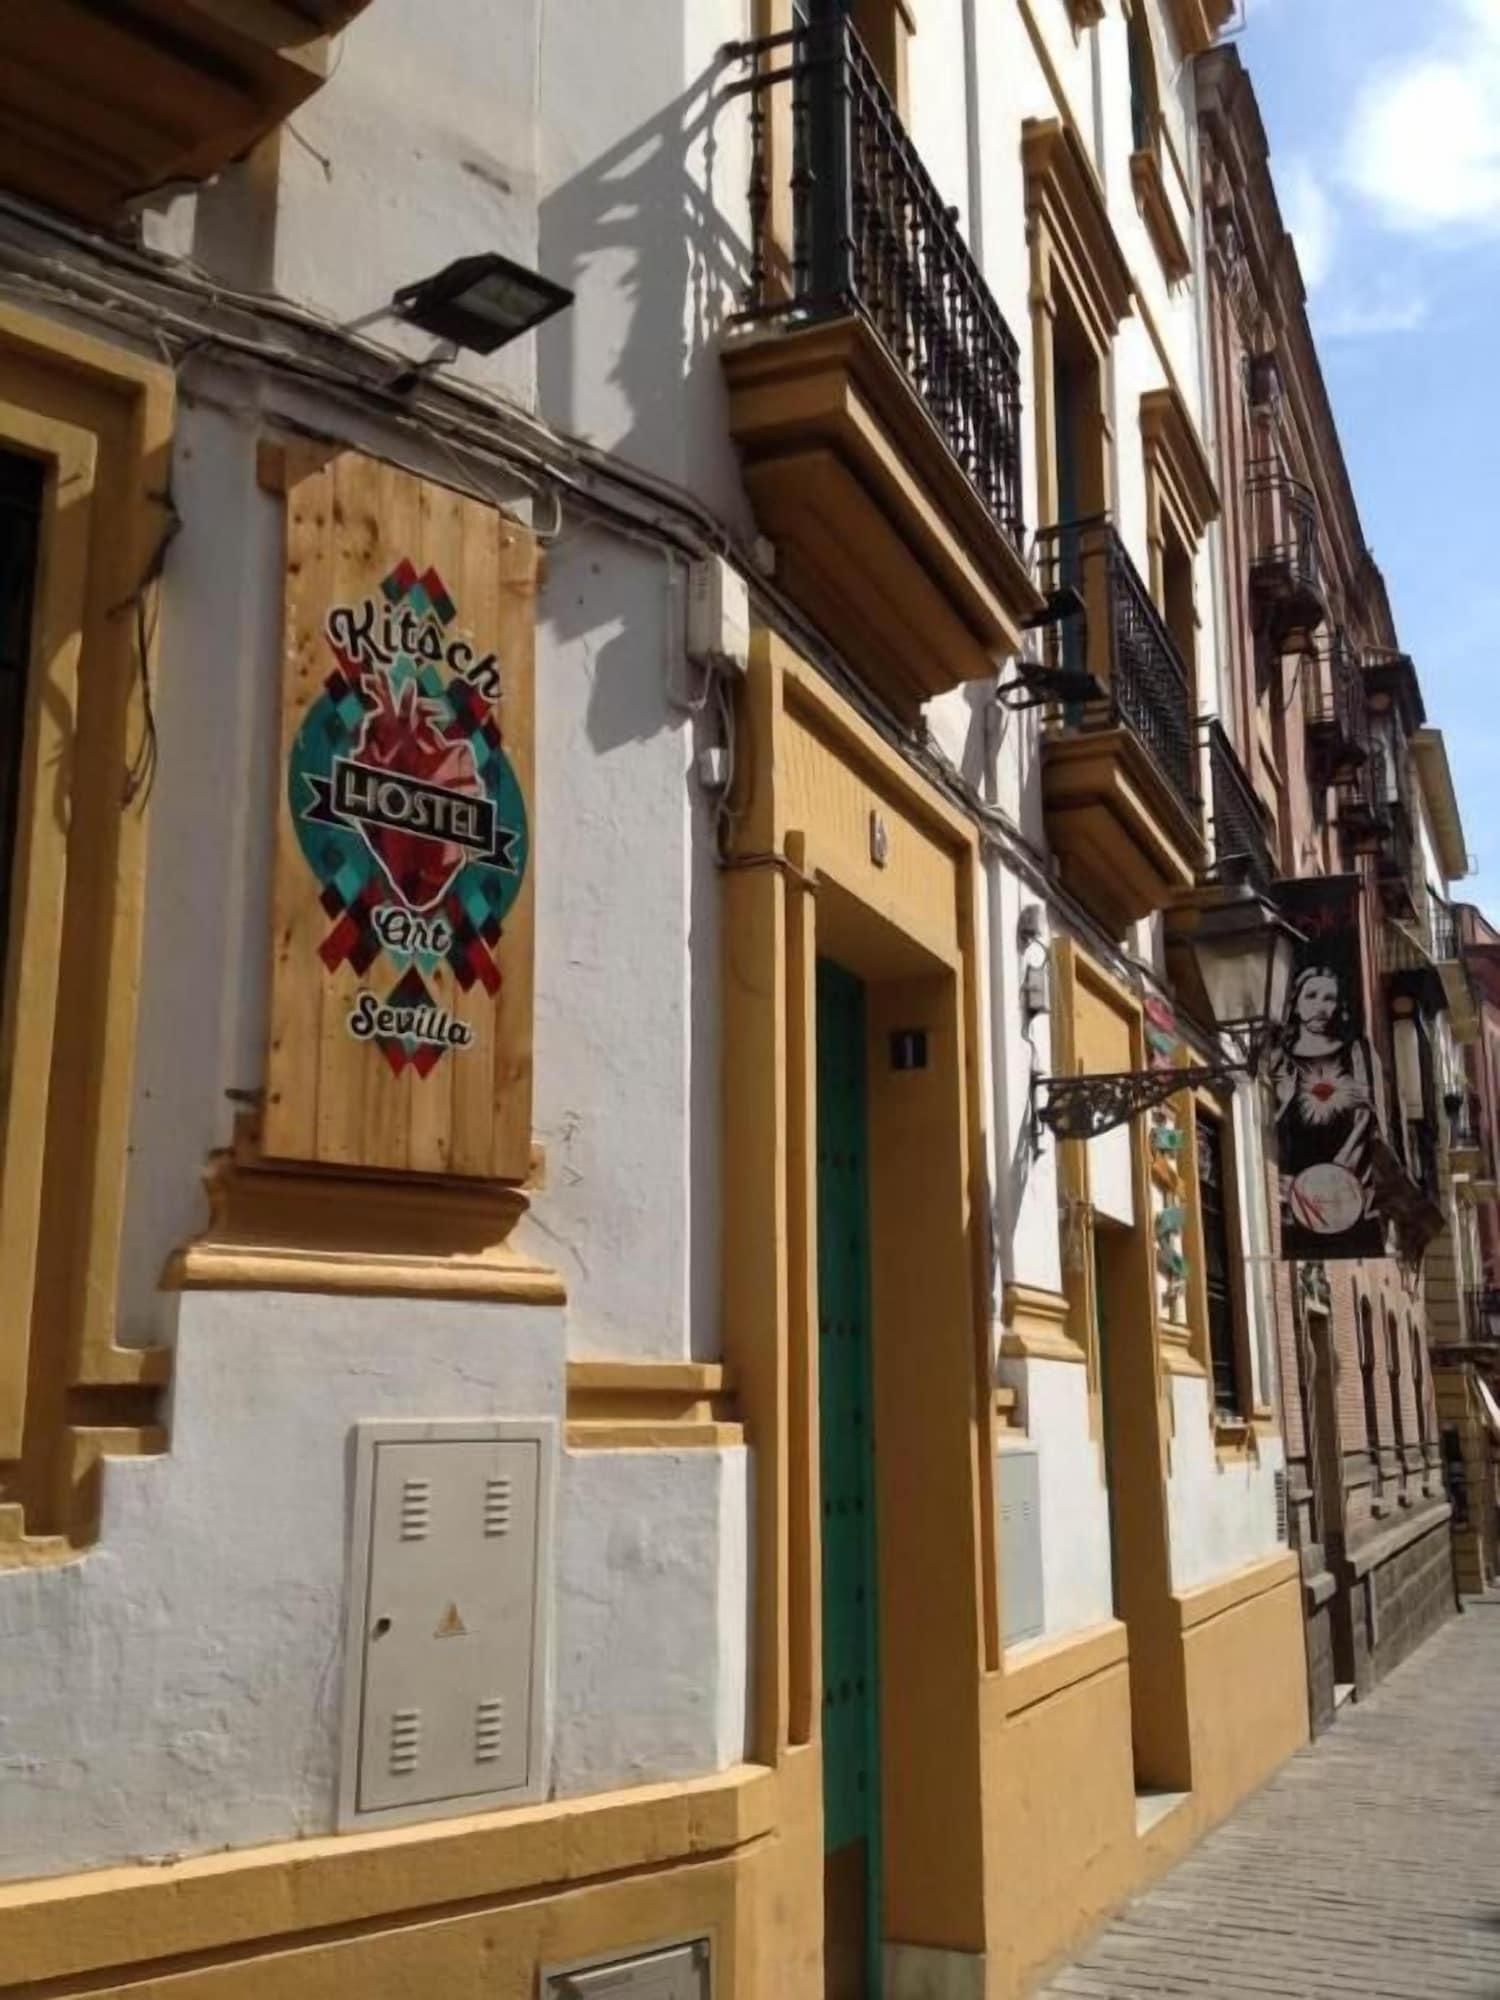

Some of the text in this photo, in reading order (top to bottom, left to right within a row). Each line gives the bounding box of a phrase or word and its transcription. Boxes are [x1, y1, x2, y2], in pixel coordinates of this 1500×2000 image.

[343, 769, 486, 842] HOSTEL
[377, 908, 452, 952] Art
[350, 994, 473, 1045] Sevilla
